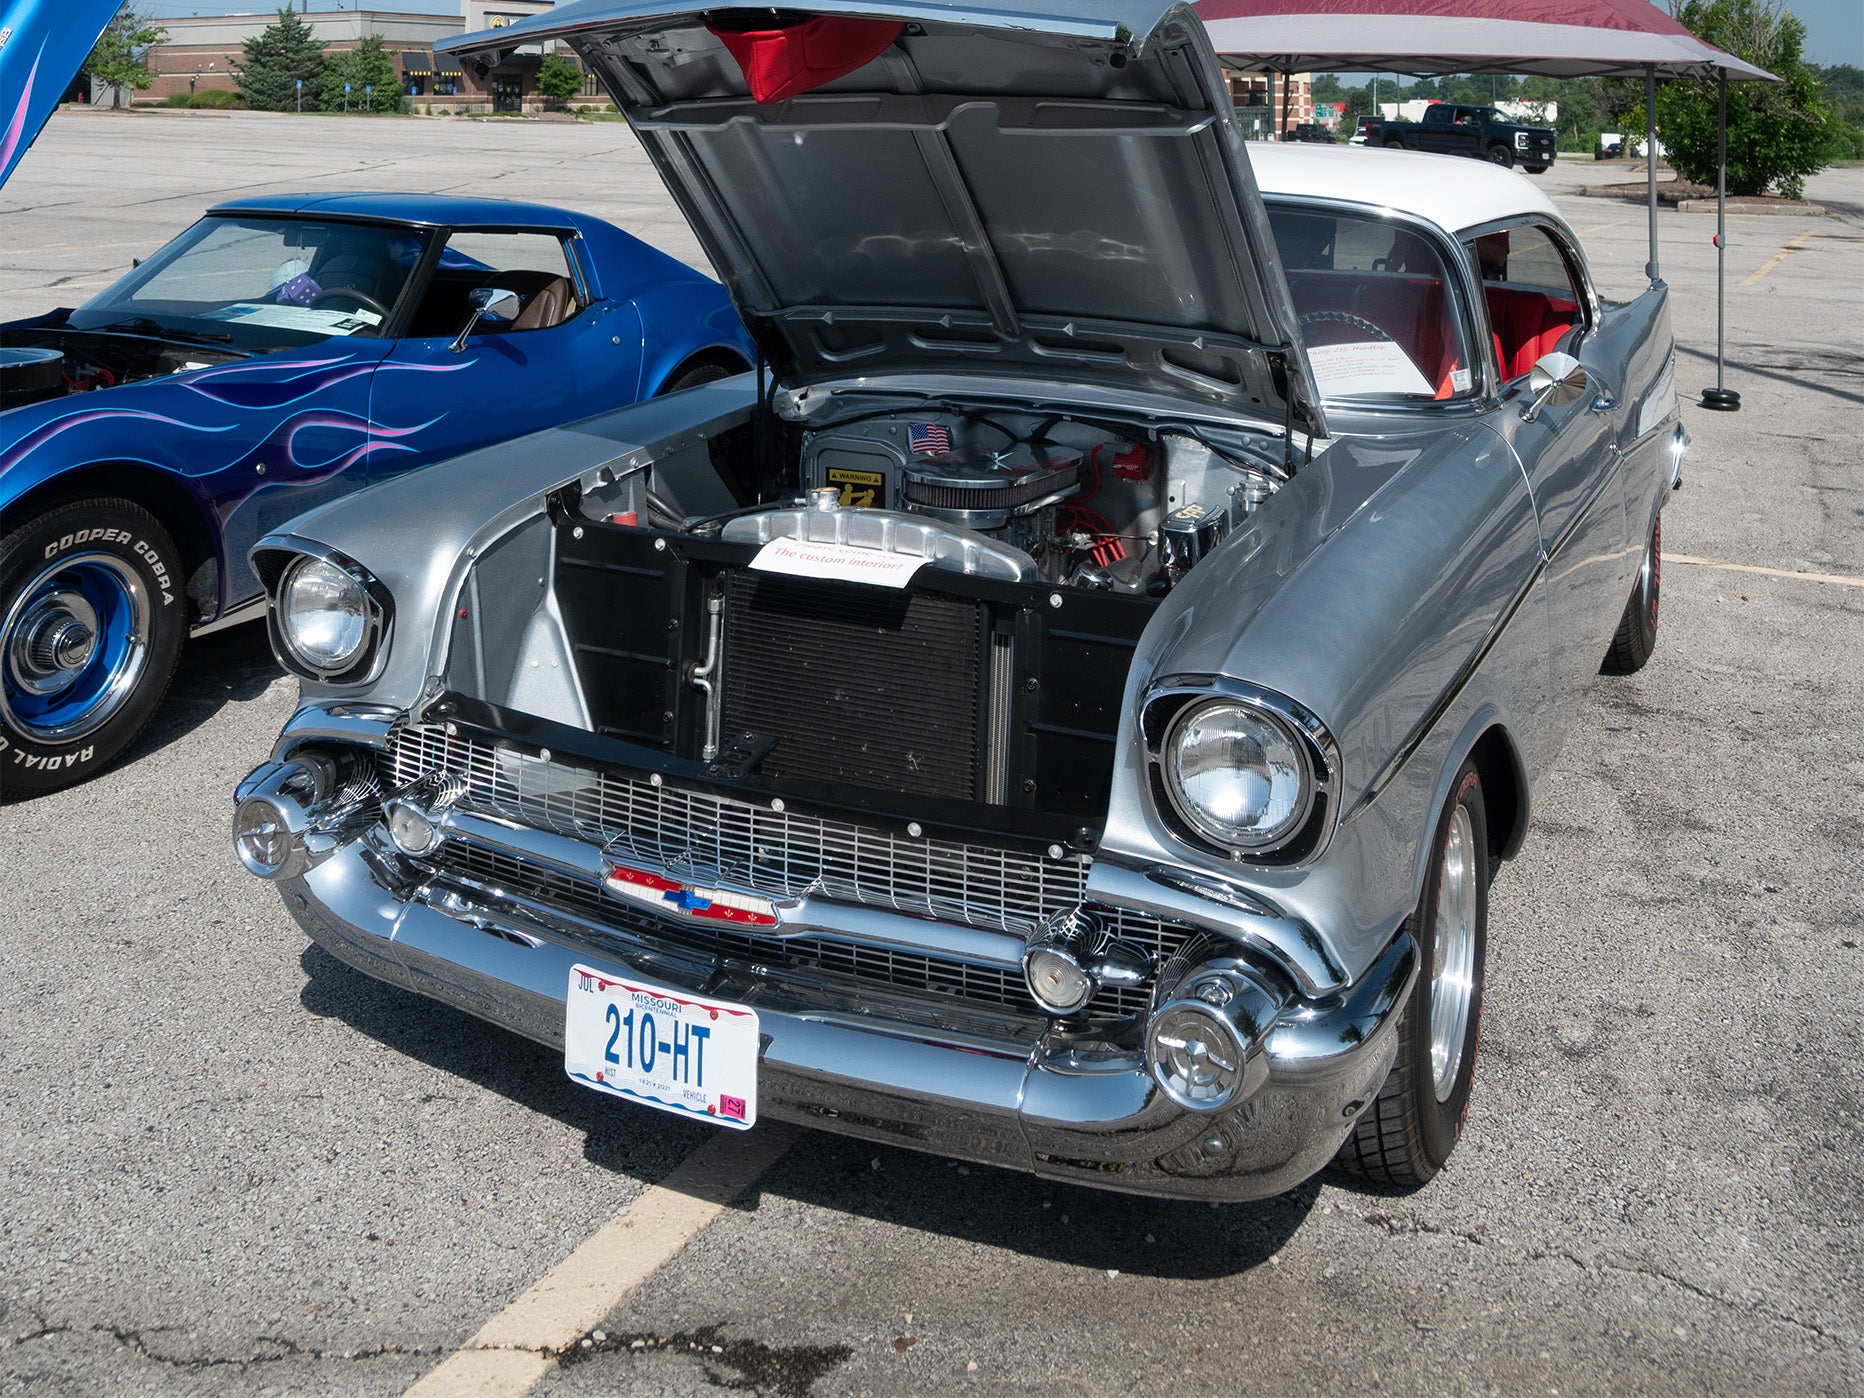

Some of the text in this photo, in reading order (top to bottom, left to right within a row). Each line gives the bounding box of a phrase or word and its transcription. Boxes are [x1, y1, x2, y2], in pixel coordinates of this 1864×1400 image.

[840, 473, 871, 482] WARNING
[44, 528, 174, 606] COOPER COBRA
[773, 547, 904, 571] The custom interior!
[13, 745, 94, 770] RADIAL
[578, 976, 594, 993] JUL
[631, 992, 682, 1014] MISSOURI
[635, 1002, 678, 1019] BICENTENNIAL
[604, 1003, 711, 1088] 210-HT
[604, 1066, 617, 1078] HIST
[683, 1089, 707, 1104] VEHICLE
[728, 1099, 741, 1115] 27
